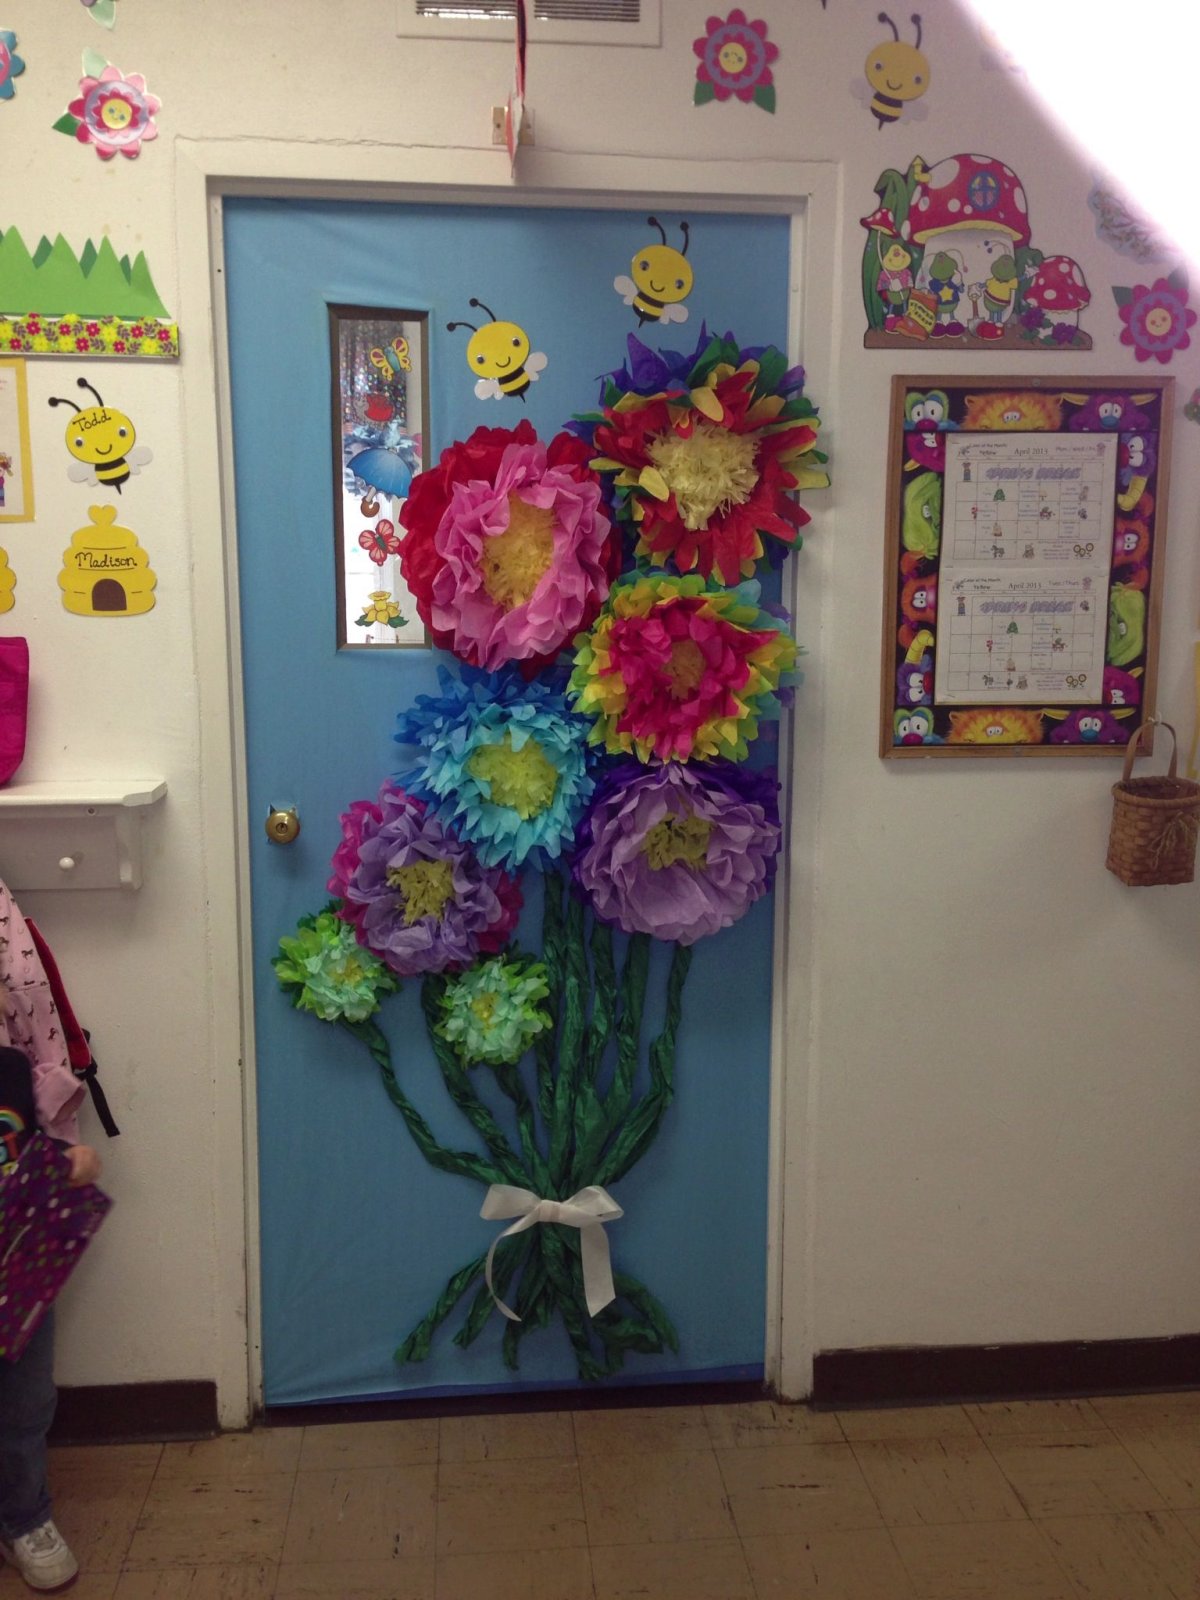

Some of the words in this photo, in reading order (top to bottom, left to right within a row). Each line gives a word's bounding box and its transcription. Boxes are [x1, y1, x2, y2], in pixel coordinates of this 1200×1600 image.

[72, 409, 112, 432] Todd
[1014, 447, 1031, 457] April
[74, 552, 138, 568] Madison
[1008, 581, 1025, 591] April
